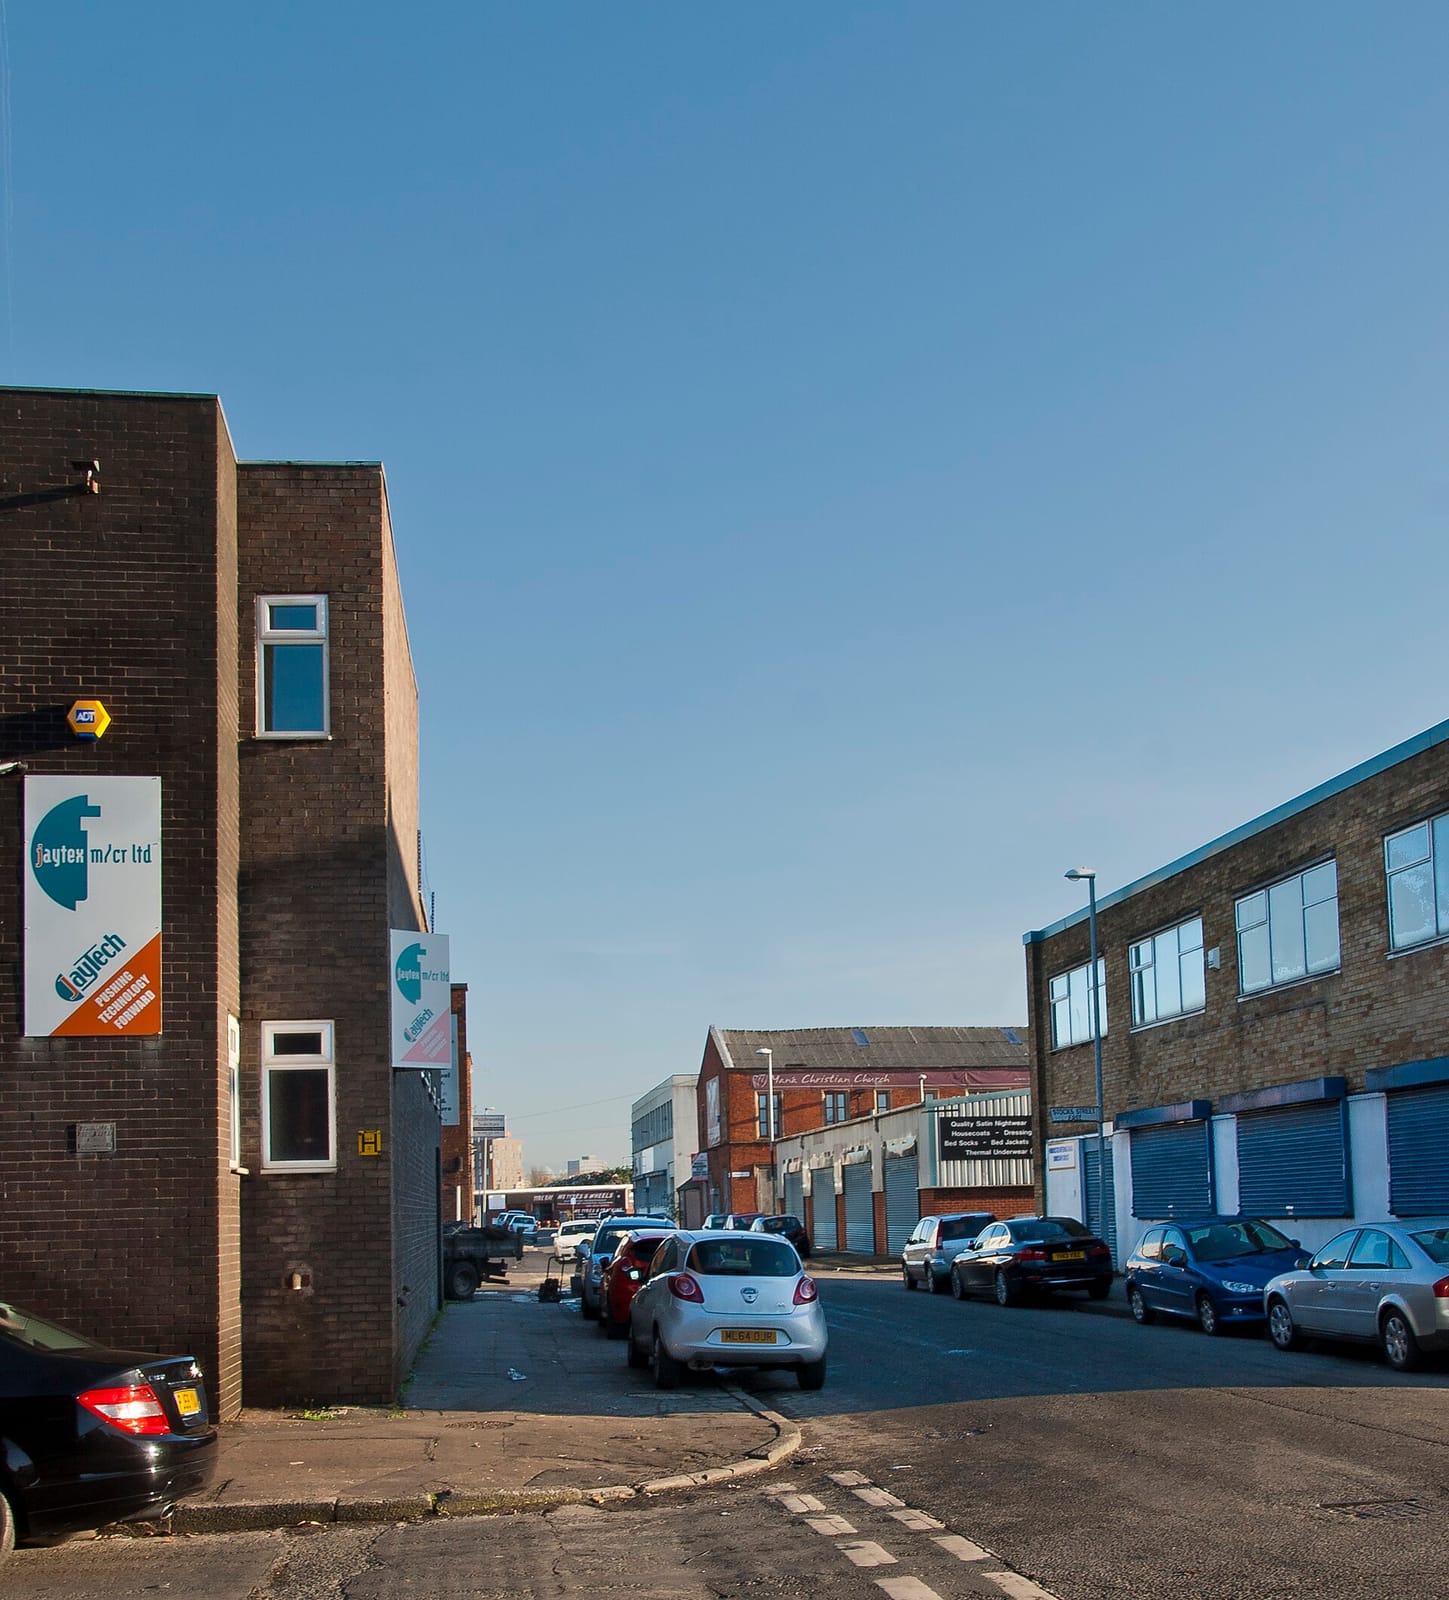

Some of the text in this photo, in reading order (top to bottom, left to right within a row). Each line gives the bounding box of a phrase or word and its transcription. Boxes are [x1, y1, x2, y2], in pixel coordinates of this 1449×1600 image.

[75, 711, 95, 722] ADT
[35, 844, 152, 868] jaytex m/cr ltd
[94, 970, 134, 1007] PUSHING
[97, 974, 150, 1024] TECHNOLOGY
[113, 990, 156, 1030] FORWARD
[801, 1073, 851, 1084] Christian
[854, 1073, 890, 1084] Church
[950, 1120, 974, 1128] Quality
[994, 1120, 1028, 1128] Nightwear
[1003, 1129, 1033, 1137] Dressing
[993, 1148, 1028, 1156] Underwear
